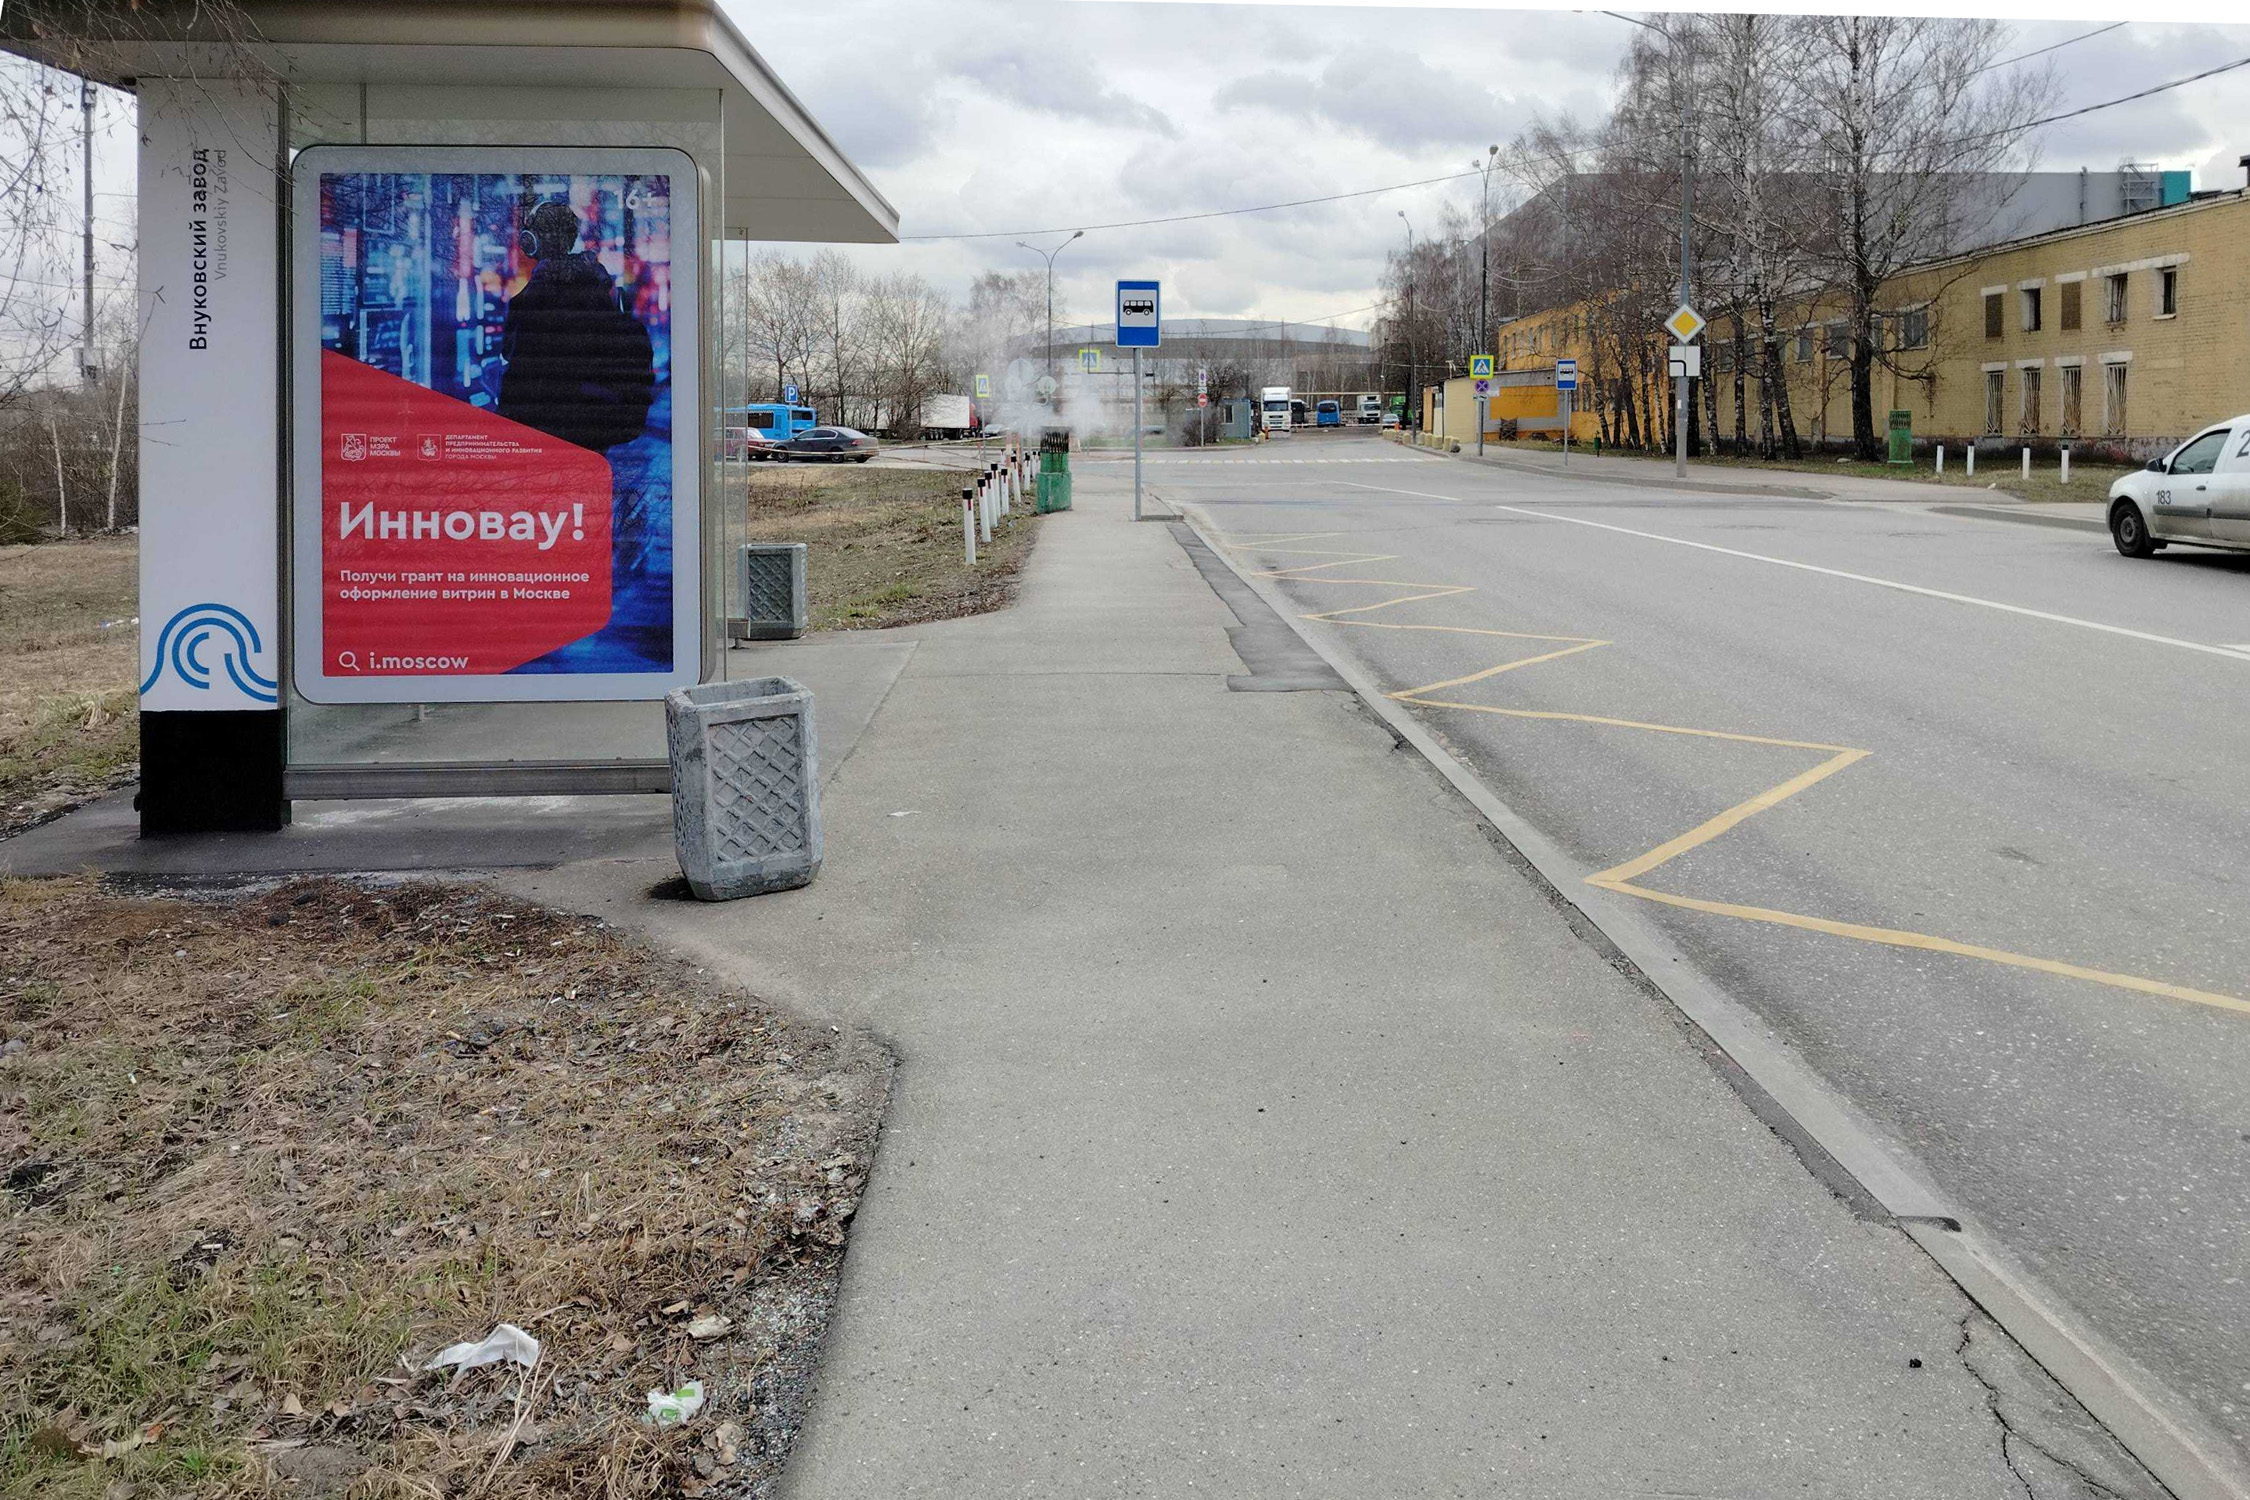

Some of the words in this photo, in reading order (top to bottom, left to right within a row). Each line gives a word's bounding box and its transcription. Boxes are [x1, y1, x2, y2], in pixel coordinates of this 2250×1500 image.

[193, 148, 209, 213] завод
[214, 149, 227, 194] Zavod
[614, 188, 657, 210] 16+
[214, 197, 229, 281] Vnukovskiy
[189, 220, 212, 350] Внуковский
[370, 449, 401, 457] МОСКВЫ
[2156, 490, 2171, 505] 183
[340, 501, 585, 551] Инновау!
[340, 570, 397, 585] Получи
[401, 571, 444, 585] грант
[448, 571, 465, 582] на
[470, 571, 590, 584] инновационное
[339, 586, 438, 602] оформление
[442, 588, 496, 602] витрин
[500, 589, 509, 599] в
[513, 587, 571, 600] Москве
[369, 651, 469, 669] i.moscow
